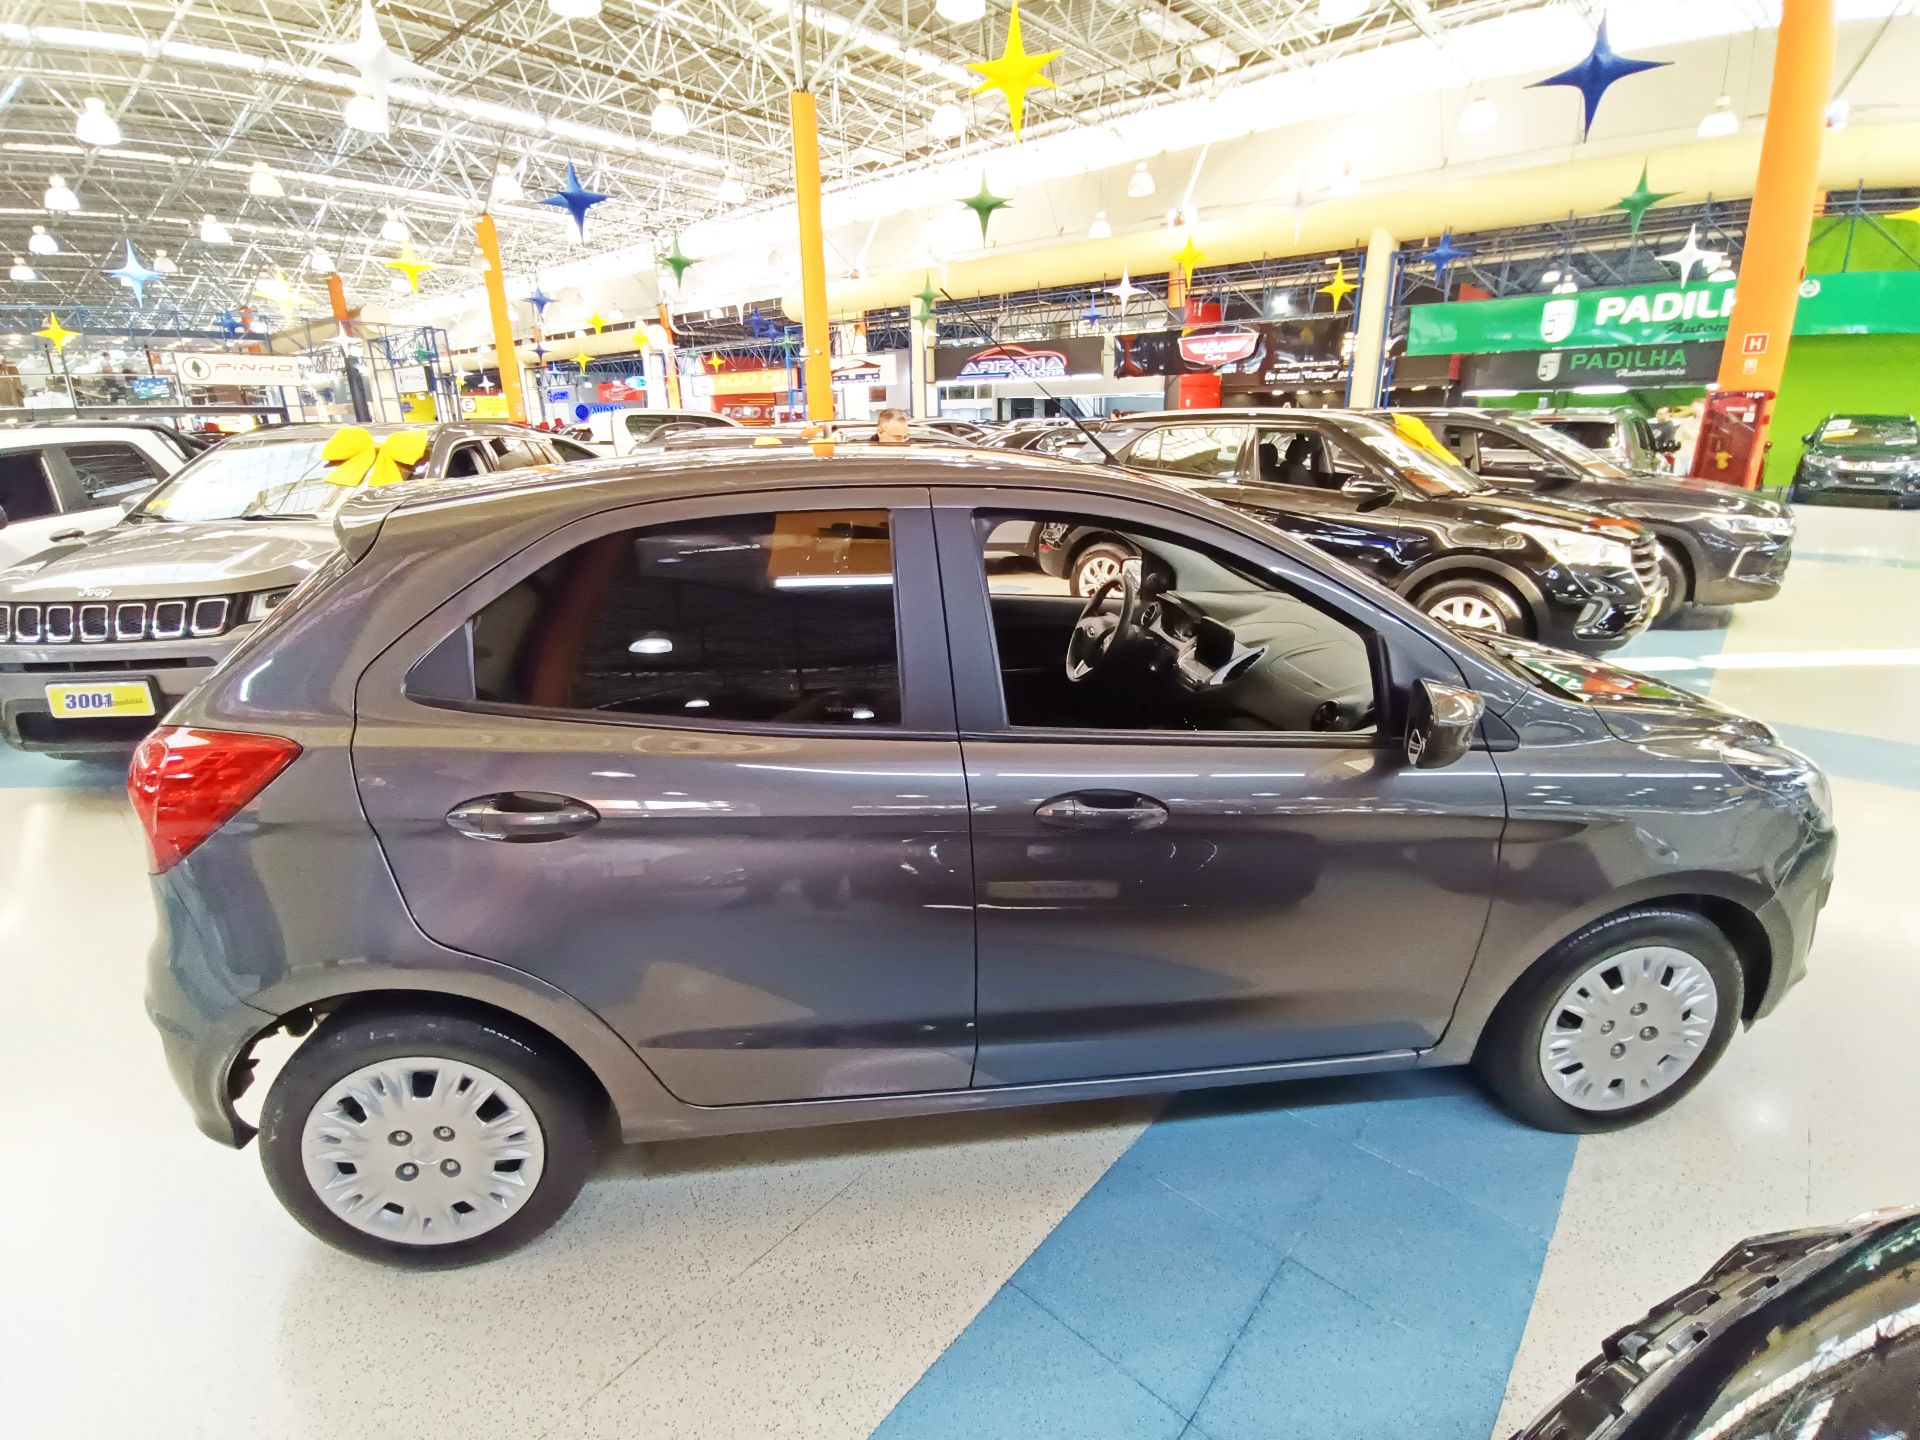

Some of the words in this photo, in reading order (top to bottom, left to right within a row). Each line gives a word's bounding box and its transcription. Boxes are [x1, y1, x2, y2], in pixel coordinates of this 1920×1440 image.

[1595, 289, 1738, 326] PADILH
[1660, 322, 1732, 335] Autom
[1749, 338, 1762, 350] H
[961, 356, 1065, 375] ARIZONA
[1569, 349, 1687, 369] PADILHA
[78, 585, 112, 598] Jeep
[65, 694, 113, 709] 3001
